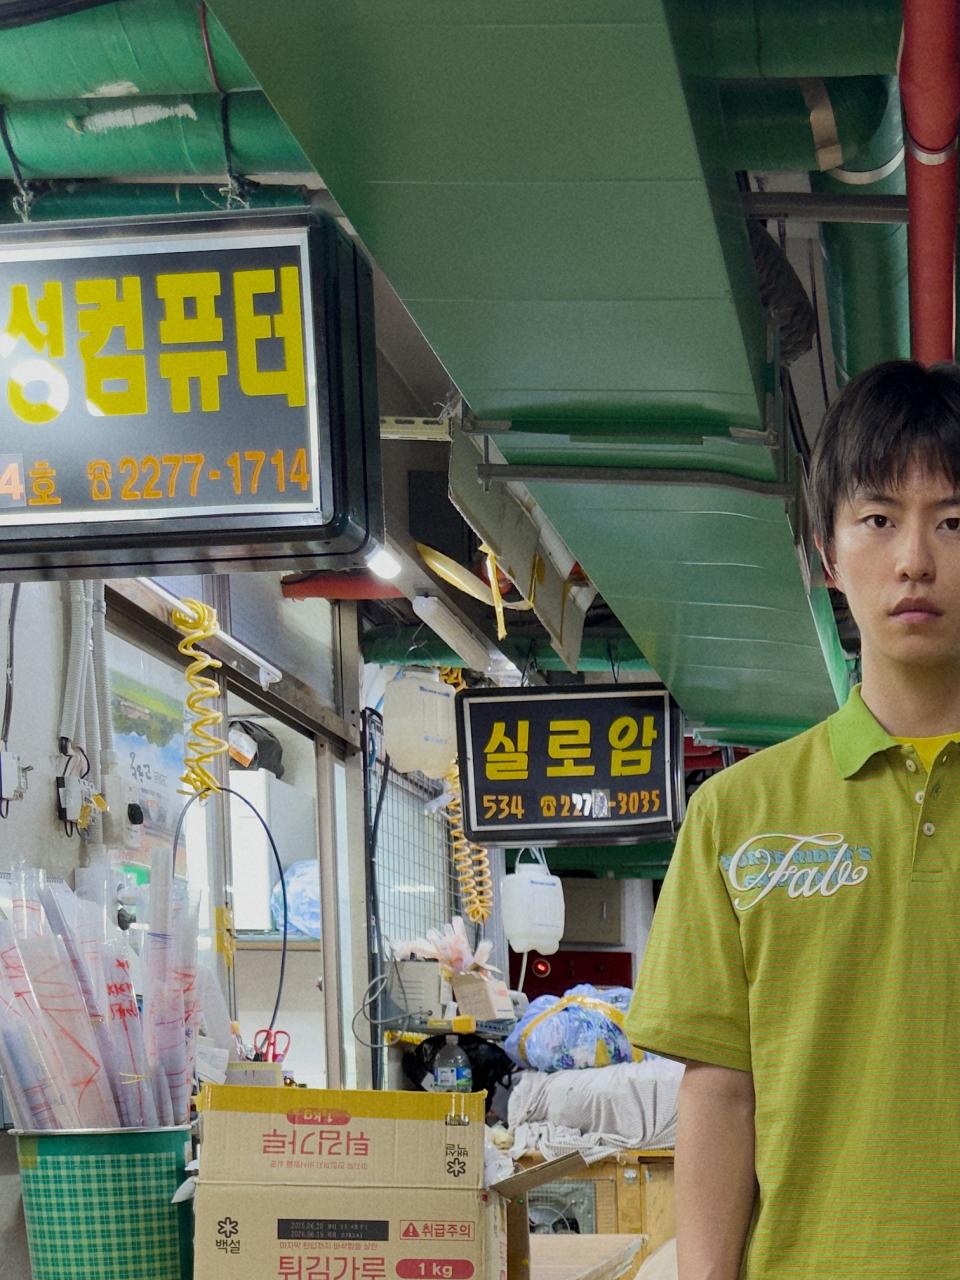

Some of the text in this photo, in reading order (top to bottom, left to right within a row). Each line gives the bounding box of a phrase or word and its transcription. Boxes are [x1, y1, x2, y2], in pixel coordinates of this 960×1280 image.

[119, 448, 312, 501] 2277-1714
[483, 715, 658, 781] 실로암
[482, 789, 661, 820] 534 227-3035
[262, 1129, 370, 1156] 튀김가루
[421, 1222, 471, 1238] 취급주의
[215, 1238, 241, 1254] 백설
[432, 1262, 453, 1279] kg
